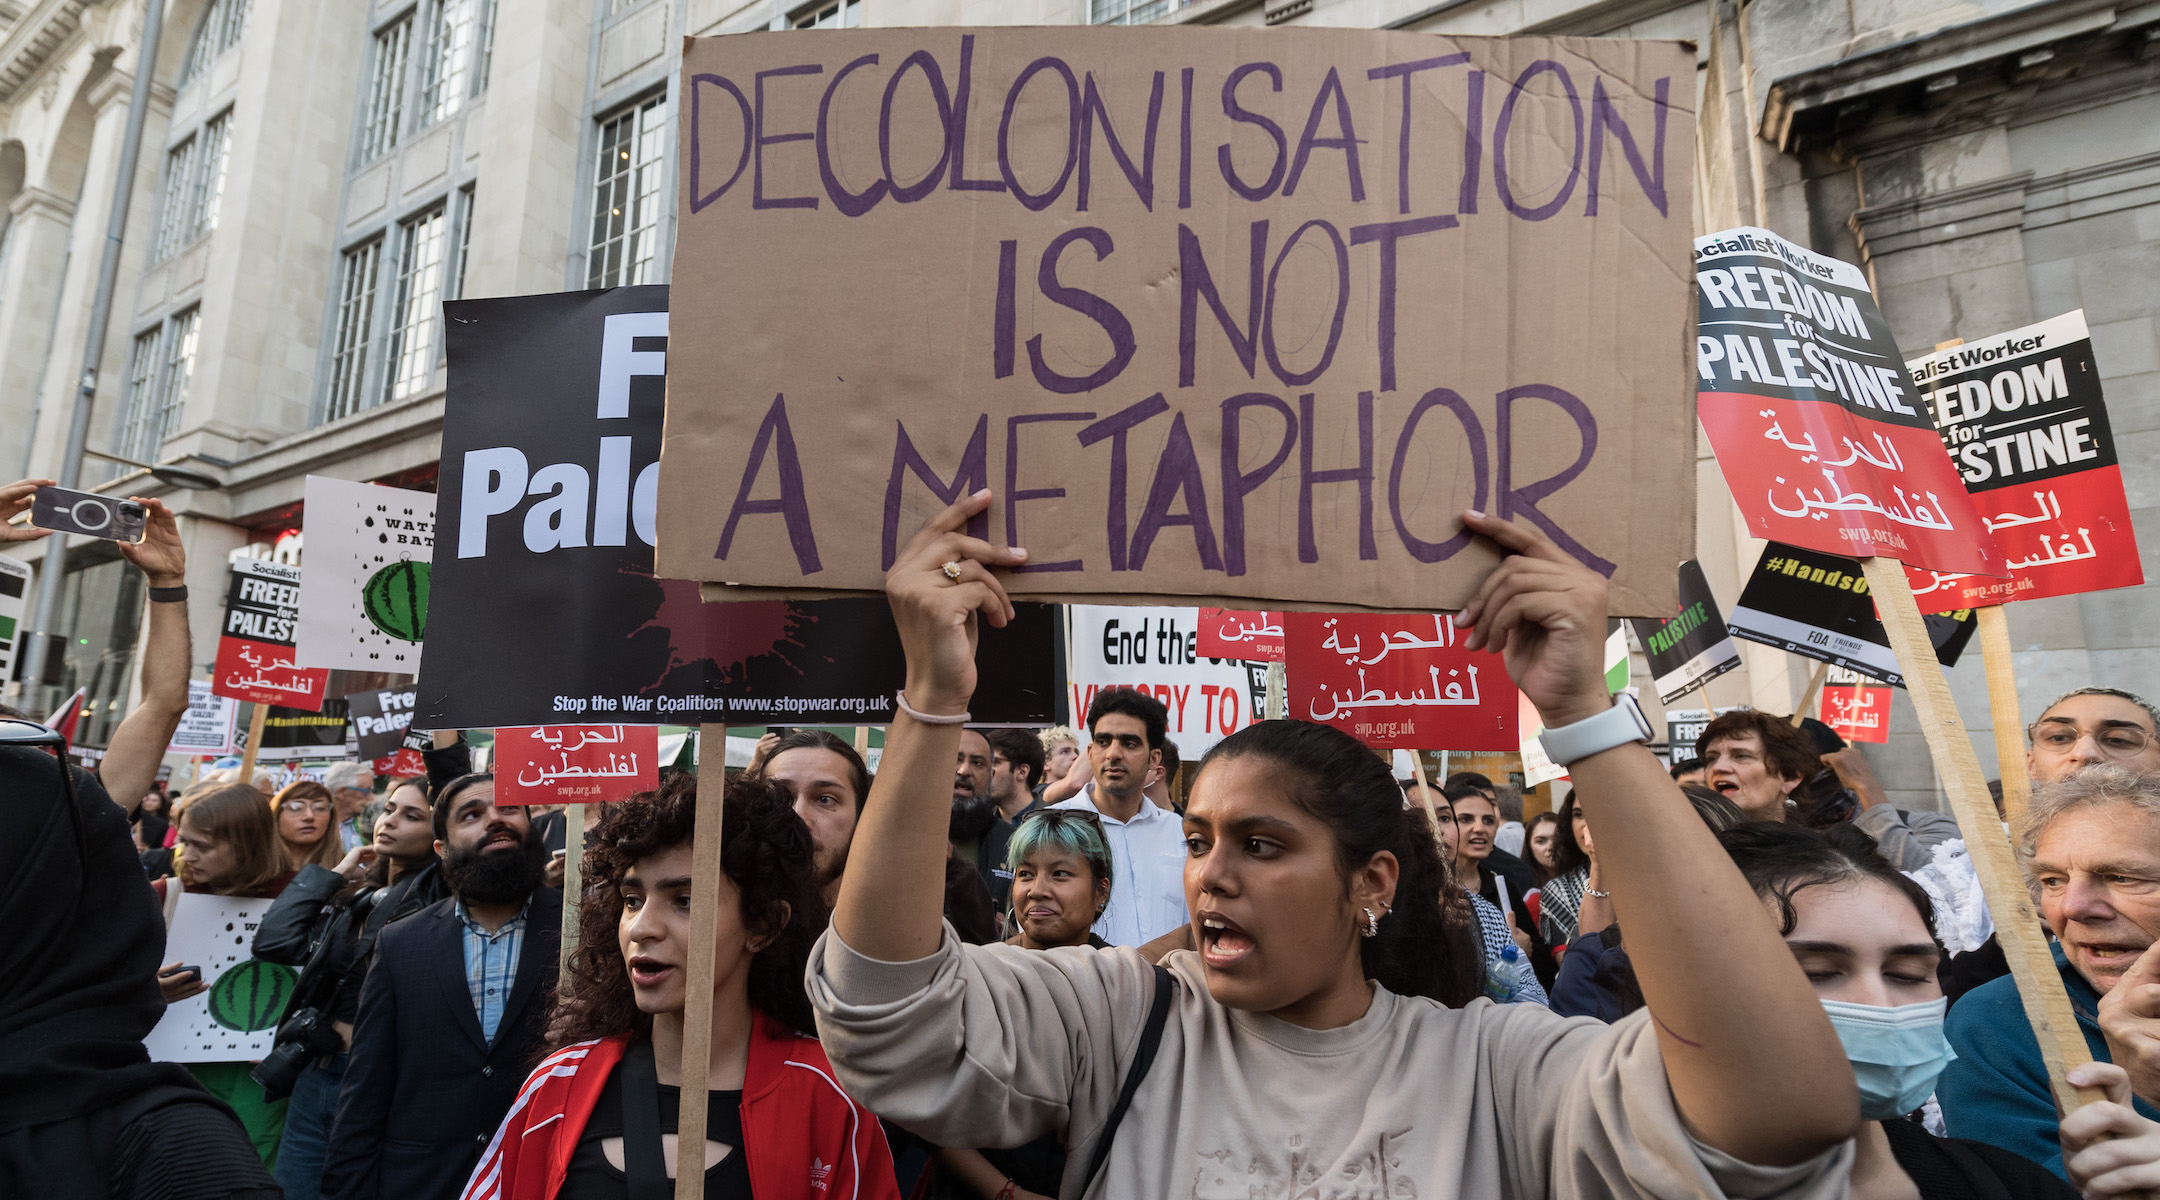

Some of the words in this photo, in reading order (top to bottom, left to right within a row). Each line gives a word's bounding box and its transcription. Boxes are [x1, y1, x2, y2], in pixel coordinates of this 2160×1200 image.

[690, 34, 1670, 219] DECOLONISATION
[1774, 239, 1834, 280] Worker
[994, 226, 1137, 394] IS
[1178, 214, 1459, 392] NOT
[1784, 313, 1815, 341] for
[1958, 334, 2046, 368] Worker
[1697, 334, 1918, 417] PALESTINE
[1758, 407, 1904, 473] الحرية
[1949, 422, 1983, 446] for
[714, 393, 824, 575] A
[881, 383, 1617, 580] METAPHOR
[1767, 468, 1955, 531] لفلسطين
[252, 563, 298, 580] Socialist
[1962, 576, 2035, 599] swp.org.uk
[277, 606, 294, 619] for
[1648, 601, 1709, 657] PALESTINE
[1103, 617, 1149, 665] End
[1157, 617, 1197, 665] the
[1256, 644, 1285, 655] swp.or
[1321, 613, 1455, 666] الحرية
[1807, 630, 1830, 646] FOA
[225, 669, 314, 694] لفلسطين
[1310, 663, 1480, 721] لفلسطين
[552, 694, 588, 714] Stop
[591, 694, 618, 711] the
[622, 694, 654, 711] War
[656, 694, 724, 713] Coalition
[728, 694, 890, 714] www.stopwar.org.uk
[1201, 684, 1239, 737] TO
[1354, 718, 1415, 738] swp.org.uk
[517, 751, 639, 787] لفلسطين
[557, 784, 602, 798] swp.org.uk
